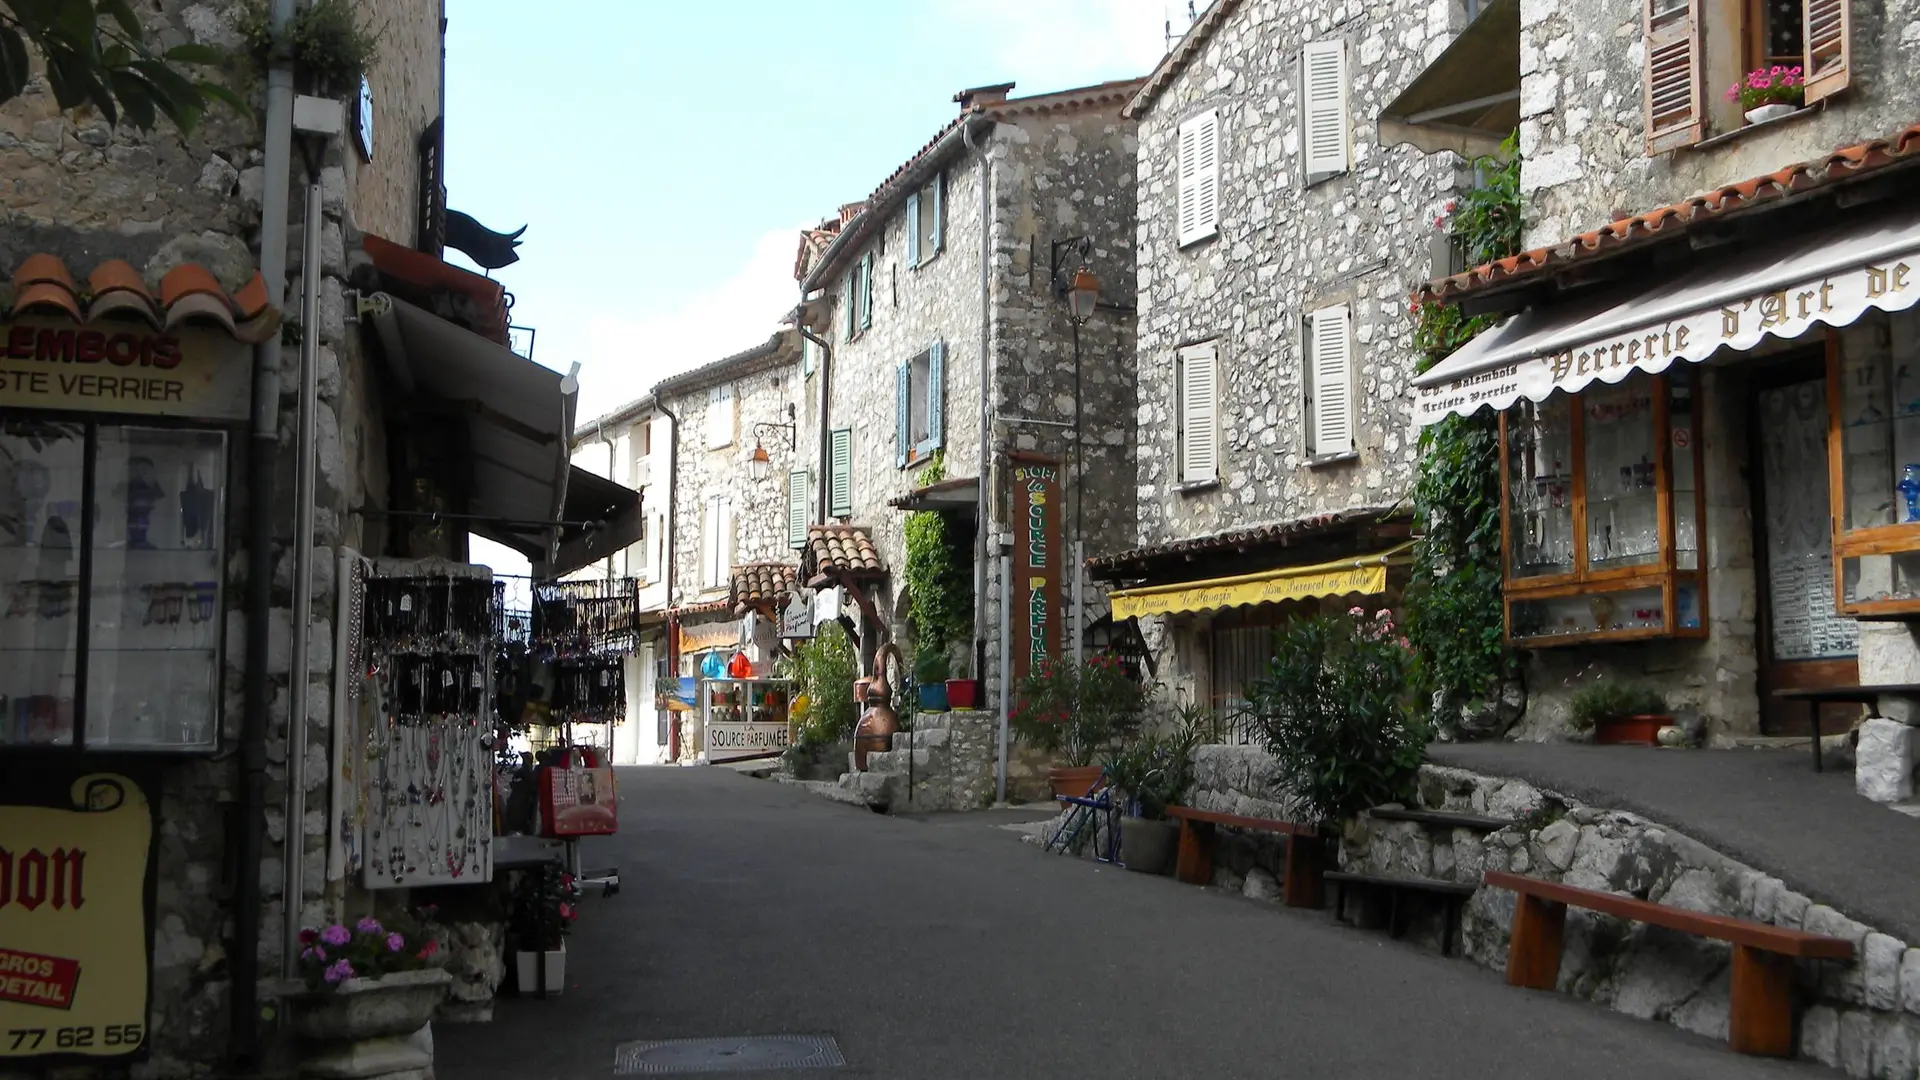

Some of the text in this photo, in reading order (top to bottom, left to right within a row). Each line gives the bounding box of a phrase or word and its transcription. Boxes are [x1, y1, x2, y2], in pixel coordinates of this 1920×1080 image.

[1545, 262, 1911, 383] Verrerie d'Art de
[58, 373, 184, 403] VERRIER
[1421, 383, 1518, 413] Artiste Verrier
[1029, 491, 1046, 568] SOURCE
[712, 727, 788, 747] SOURCE PARFUMÉE
[8, 1024, 142, 1050] 77 62 55
